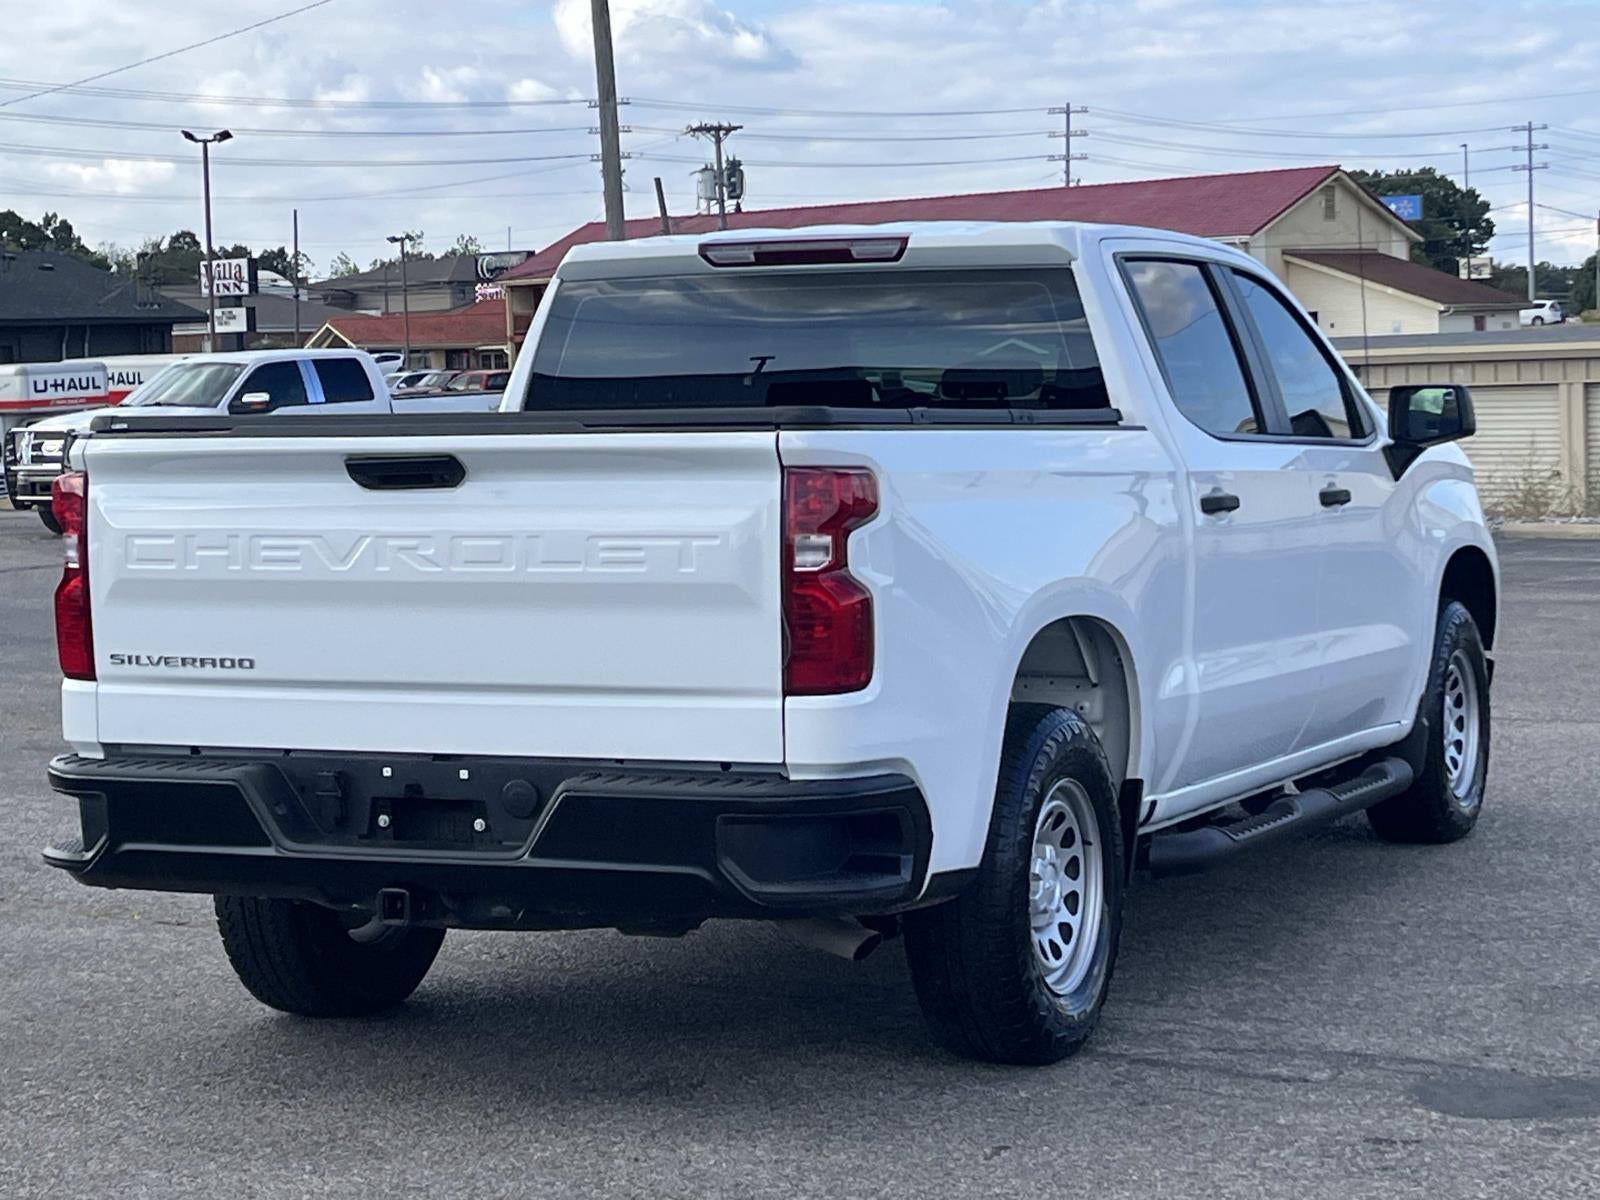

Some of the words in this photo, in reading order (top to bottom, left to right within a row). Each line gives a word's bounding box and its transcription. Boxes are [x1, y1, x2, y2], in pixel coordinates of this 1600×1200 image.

[215, 281, 244, 293] INN
[33, 376, 101, 393] U-HAUL
[125, 534, 721, 573] CHEVROLET
[109, 653, 255, 670] SILVERADO
